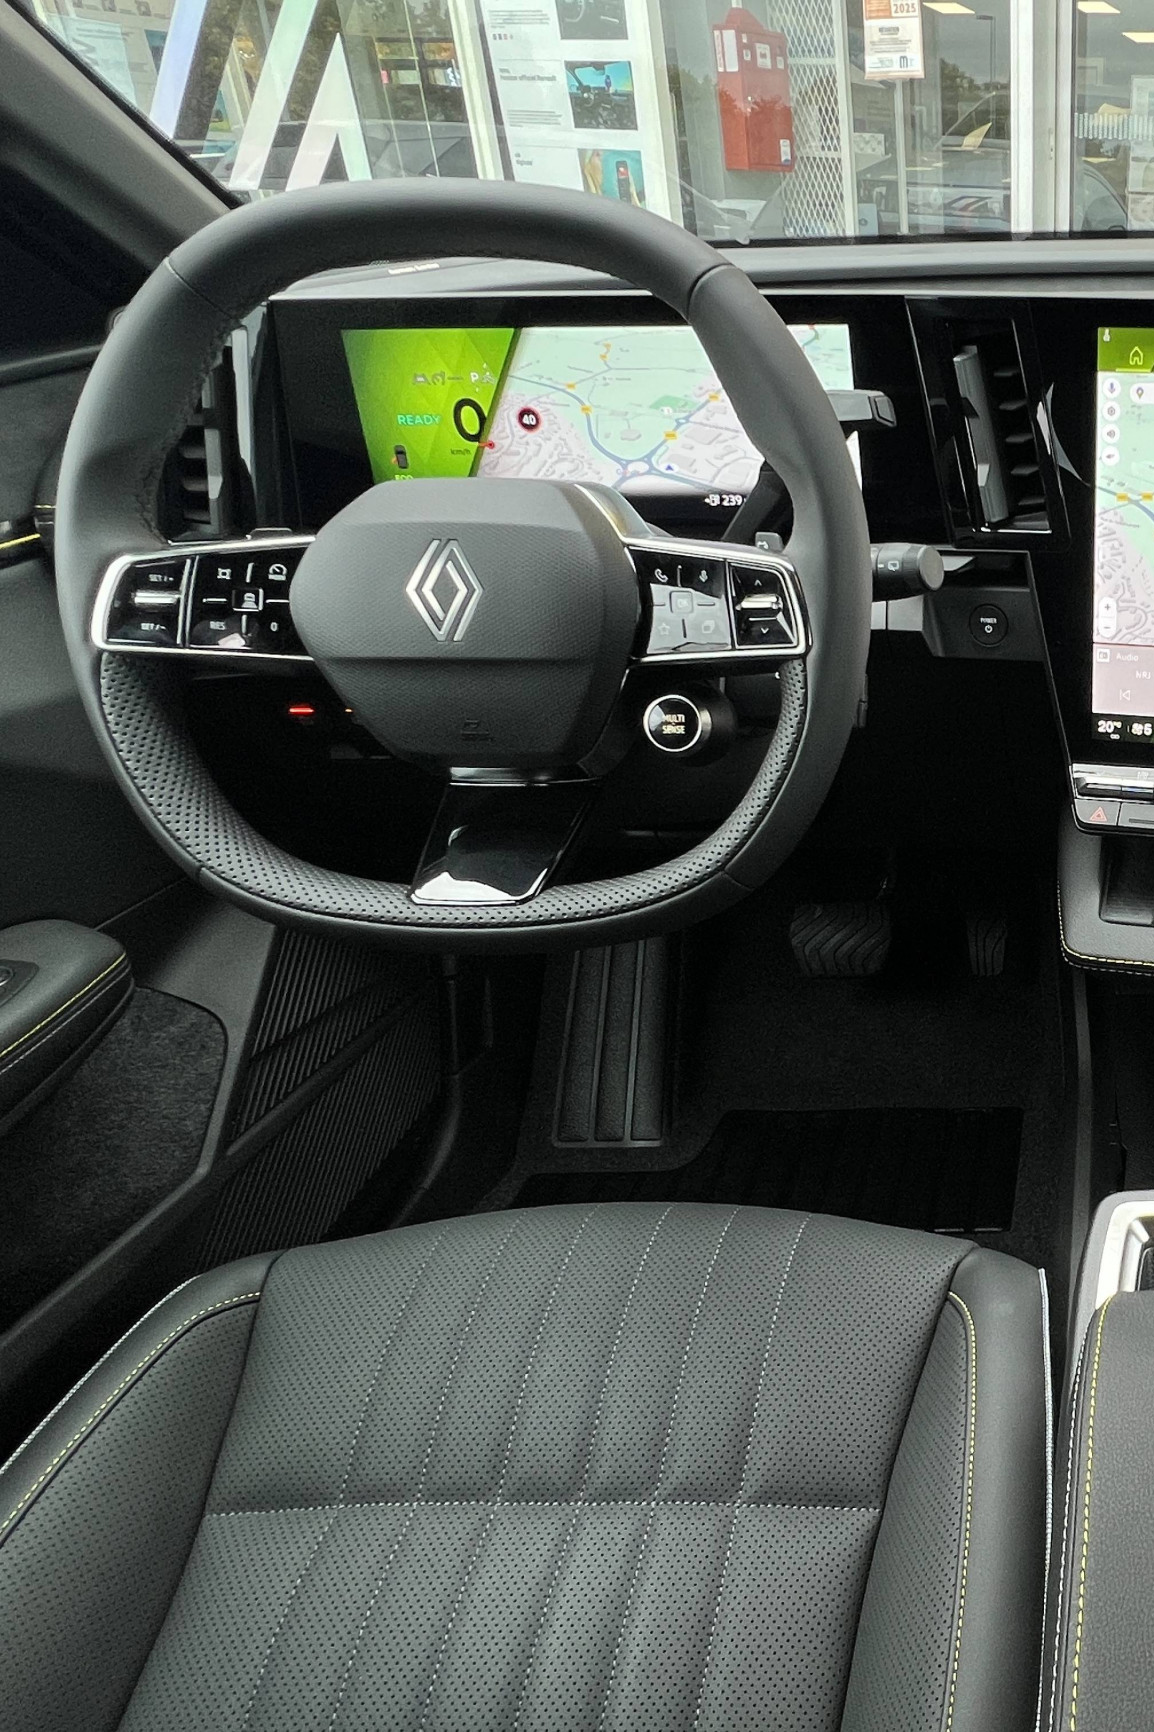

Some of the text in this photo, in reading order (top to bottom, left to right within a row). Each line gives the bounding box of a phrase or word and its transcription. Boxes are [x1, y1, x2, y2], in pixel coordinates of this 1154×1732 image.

[893, 3, 917, 14] 2025
[396, 398, 537, 443] READY 0 40
[721, 495, 743, 506] 239
[1116, 653, 1139, 662] Audio
